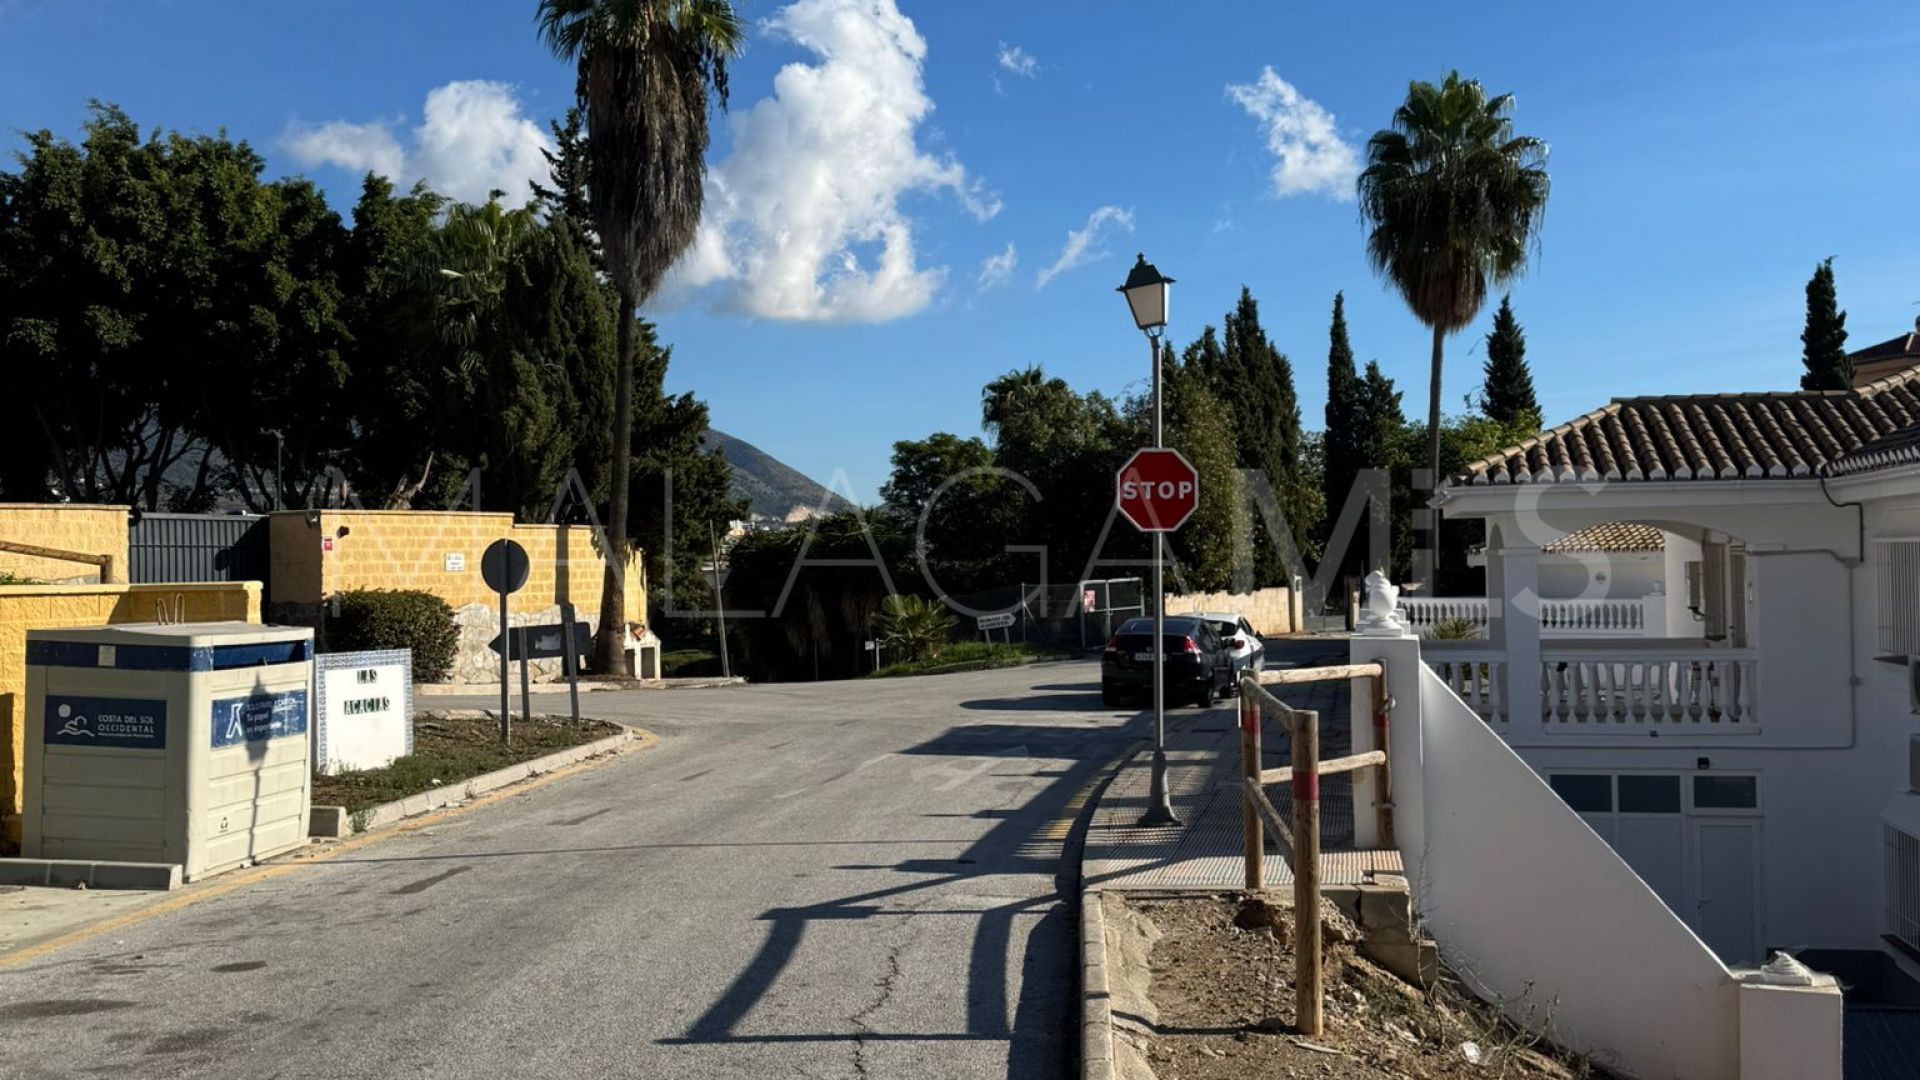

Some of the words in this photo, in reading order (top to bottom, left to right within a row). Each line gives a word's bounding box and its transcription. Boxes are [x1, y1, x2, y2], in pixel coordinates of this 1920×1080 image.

[1122, 480, 1193, 500] STOP
[357, 669, 378, 685] LAS
[344, 697, 390, 715] ACACIAS
[98, 714, 122, 723] COSTA
[124, 715, 137, 724] DEL
[140, 716, 154, 724] SOL
[98, 723, 154, 734] OCCIDENTAL
